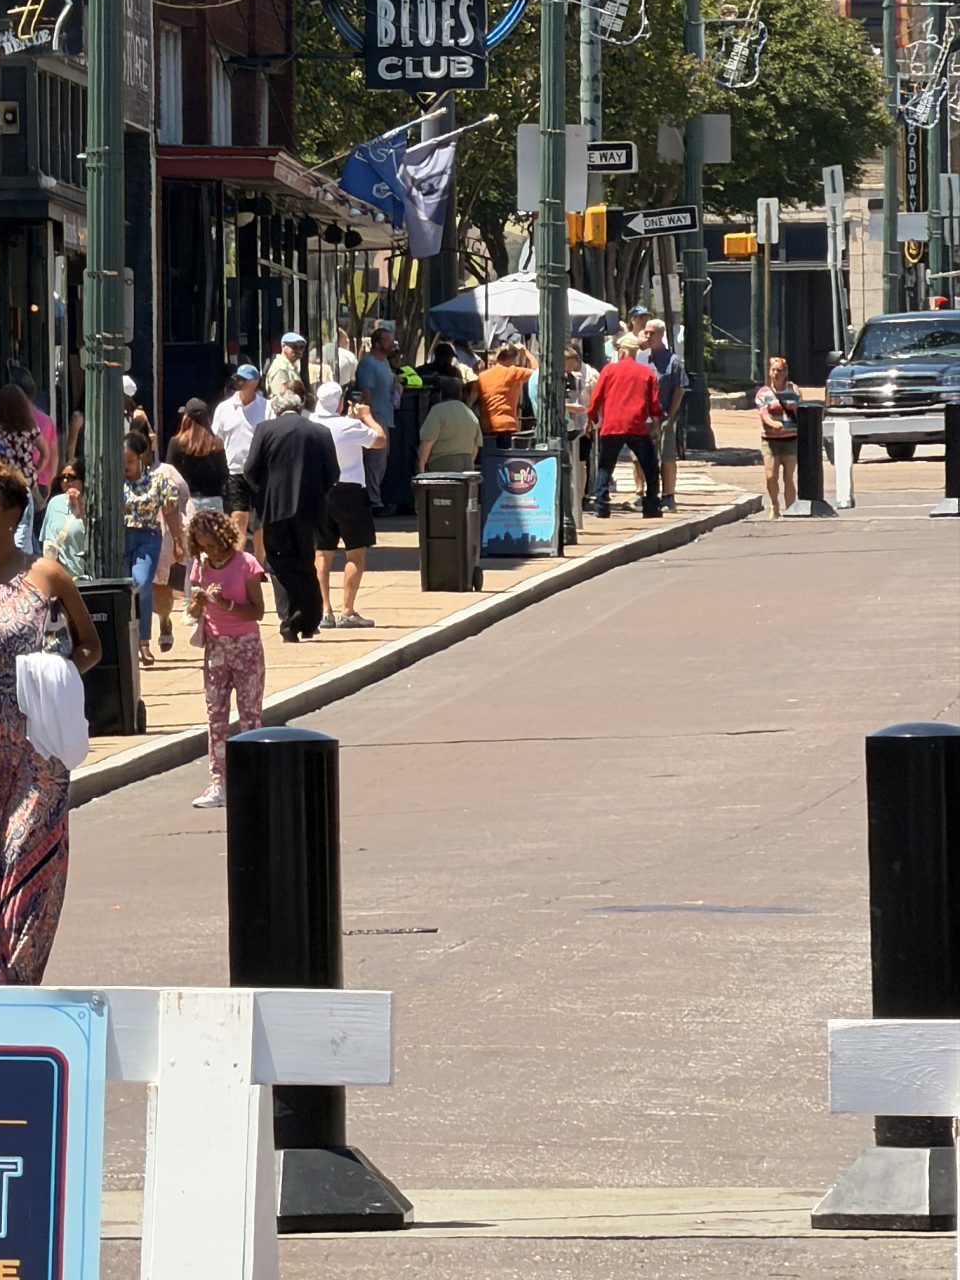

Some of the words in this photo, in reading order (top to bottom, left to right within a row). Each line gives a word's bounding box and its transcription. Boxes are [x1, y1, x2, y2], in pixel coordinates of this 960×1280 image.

[377, 55, 474, 80] CLUB
[599, 151, 624, 163] WAY
[643, 218, 664, 229] ONE
[667, 214, 690, 226] WAY
